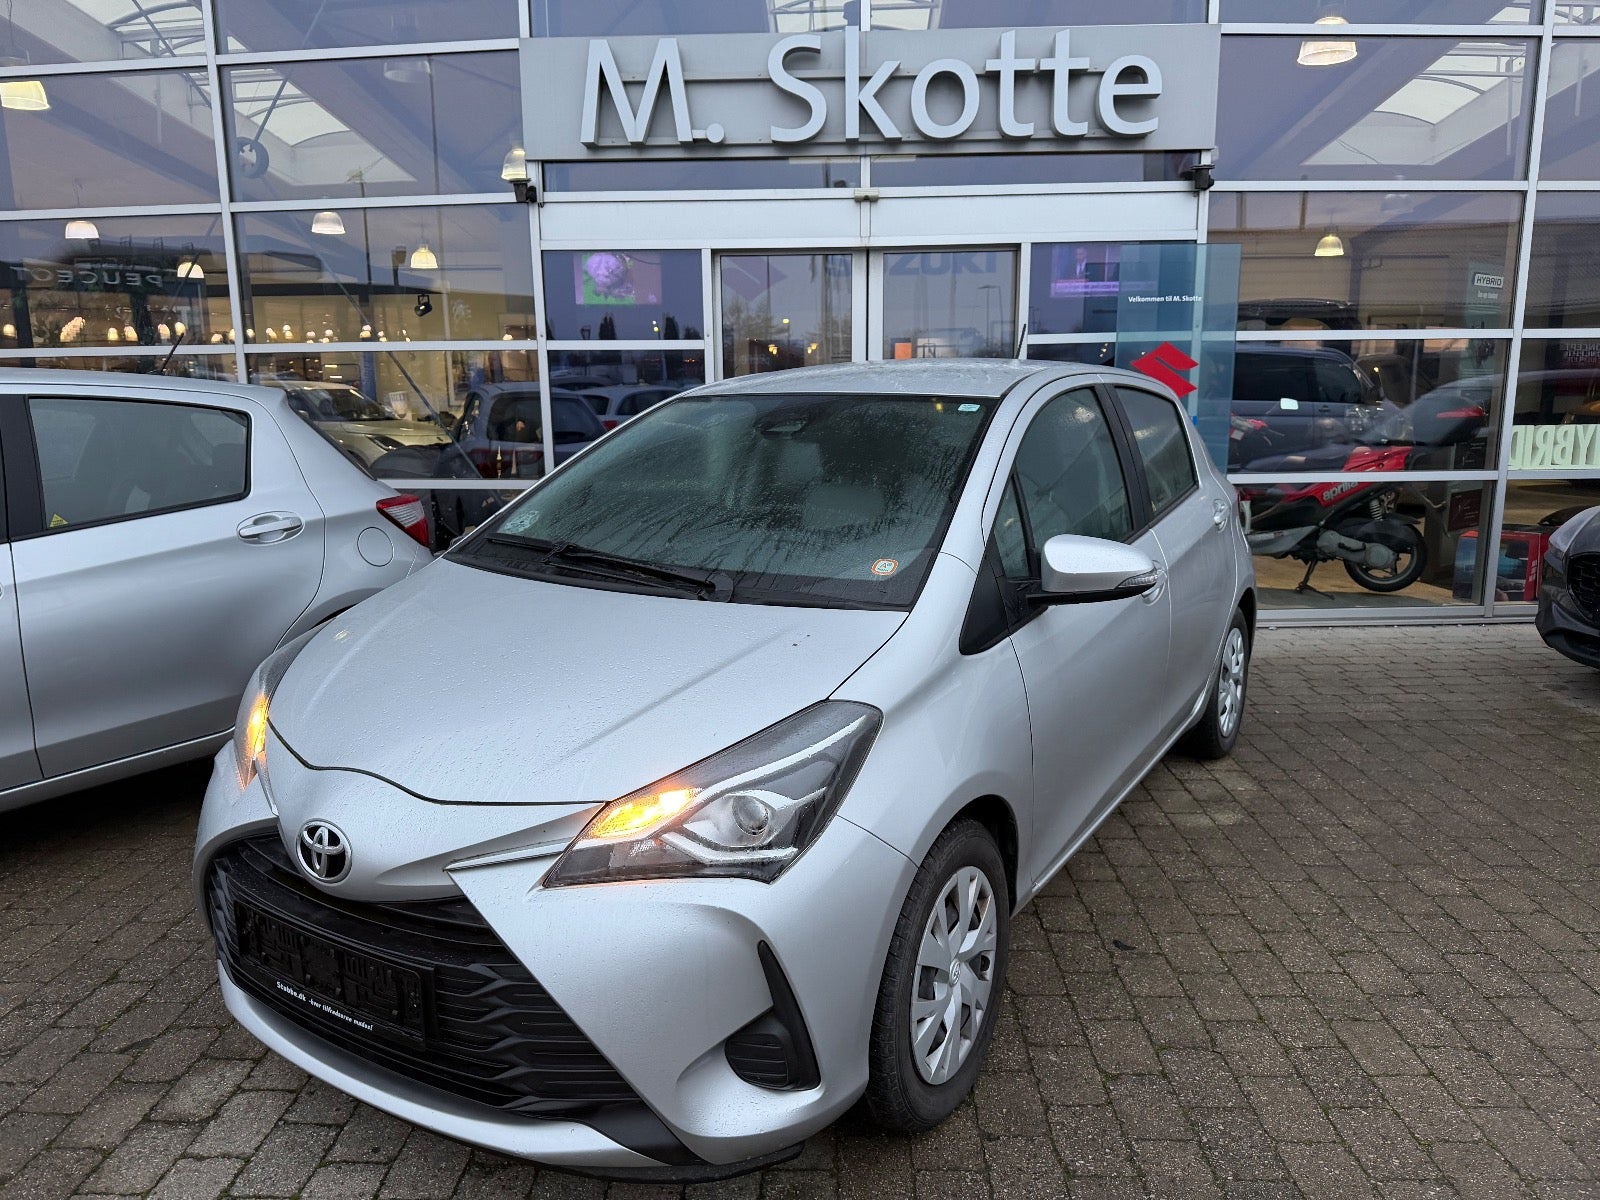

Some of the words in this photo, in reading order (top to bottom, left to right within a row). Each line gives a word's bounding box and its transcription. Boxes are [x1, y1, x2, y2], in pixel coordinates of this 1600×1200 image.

[580, 37, 726, 149] M.
[767, 25, 1164, 145] Skotte
[1476, 275, 1503, 286] HYBRID
